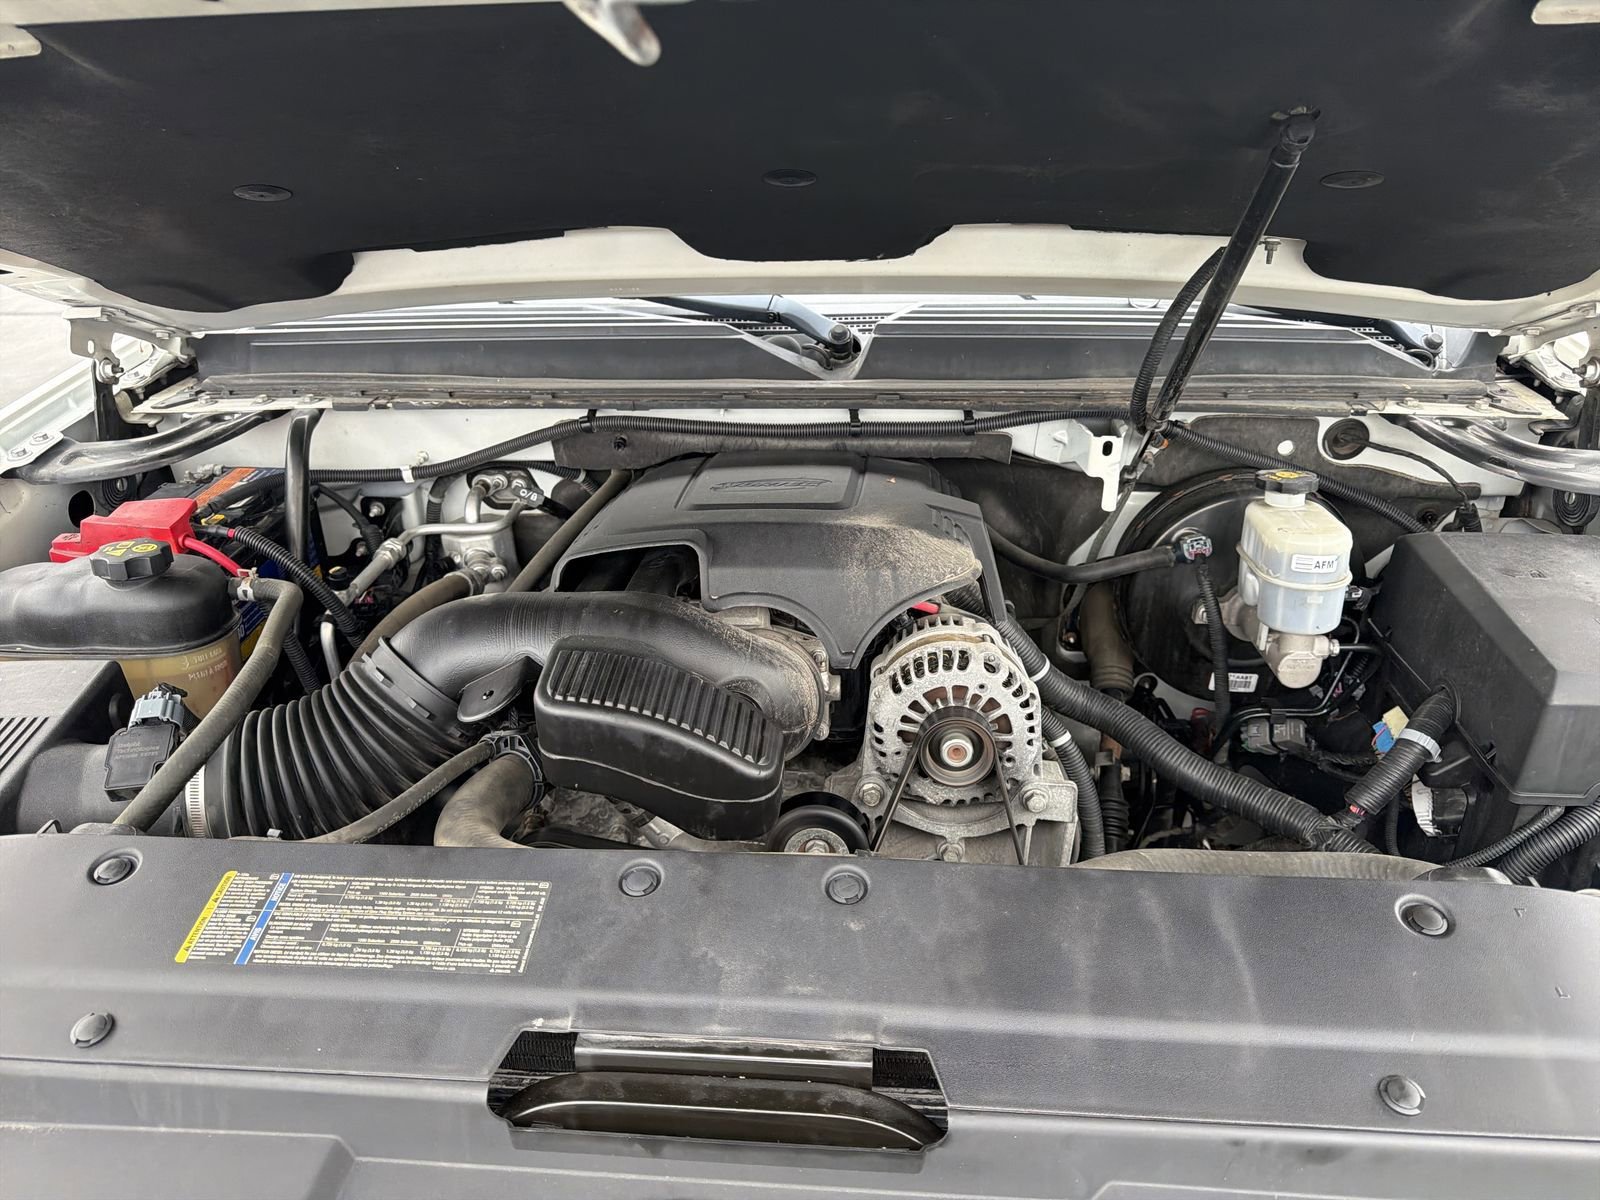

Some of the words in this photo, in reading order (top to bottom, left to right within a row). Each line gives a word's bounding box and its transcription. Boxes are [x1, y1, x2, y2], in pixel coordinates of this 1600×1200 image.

[1313, 560, 1335, 569] AFM
[215, 875, 233, 896] CAUTION
[271, 882, 287, 902] NOTICE
[187, 915, 208, 946] ATTENTION
[249, 927, 263, 941] AVIS
